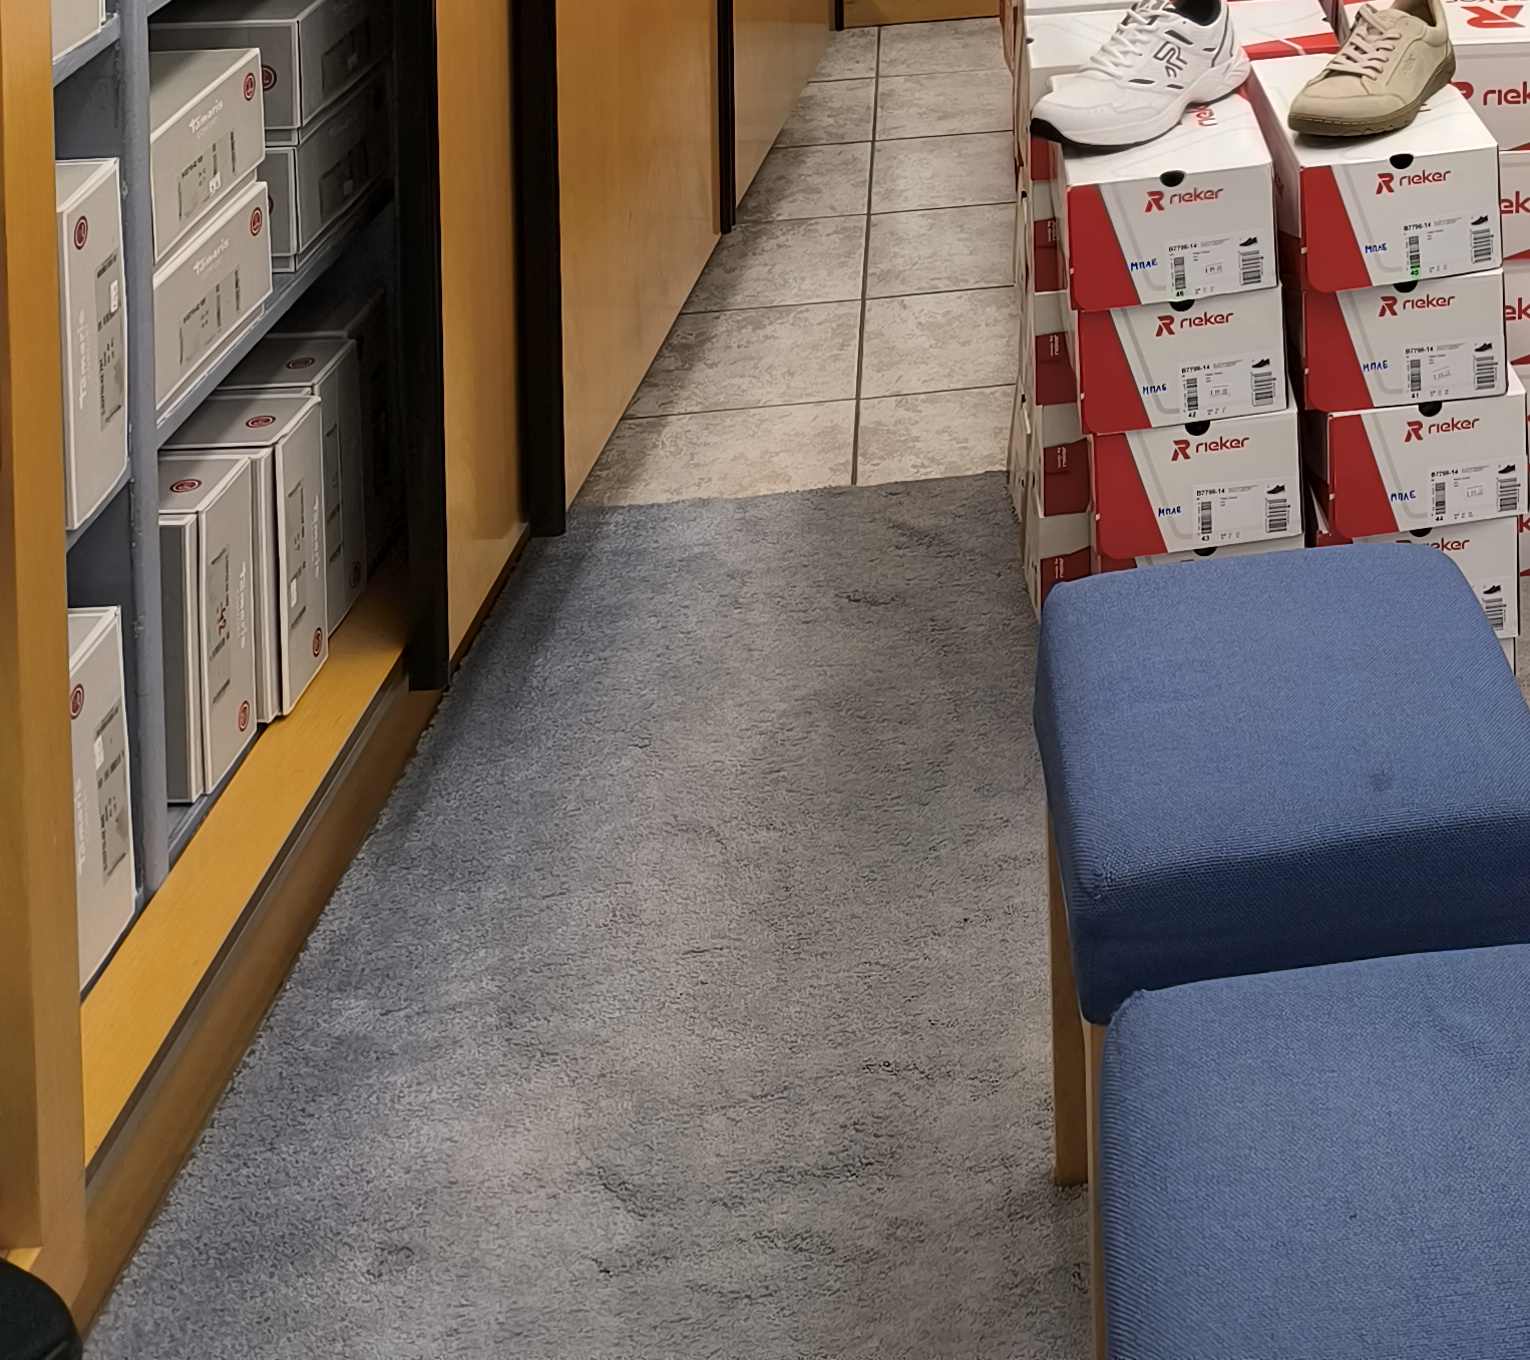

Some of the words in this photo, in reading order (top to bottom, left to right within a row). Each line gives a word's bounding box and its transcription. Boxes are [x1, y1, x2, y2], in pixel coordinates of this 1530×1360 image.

[188, 99, 224, 133] Tamaris
[1399, 170, 1451, 186] rieker
[1169, 188, 1224, 205] rieker
[193, 237, 230, 275] Tamaris
[1402, 294, 1455, 310] rieker
[1180, 312, 1234, 329] rieker
[1428, 417, 1480, 434] rieker
[1195, 436, 1250, 454] rieker
